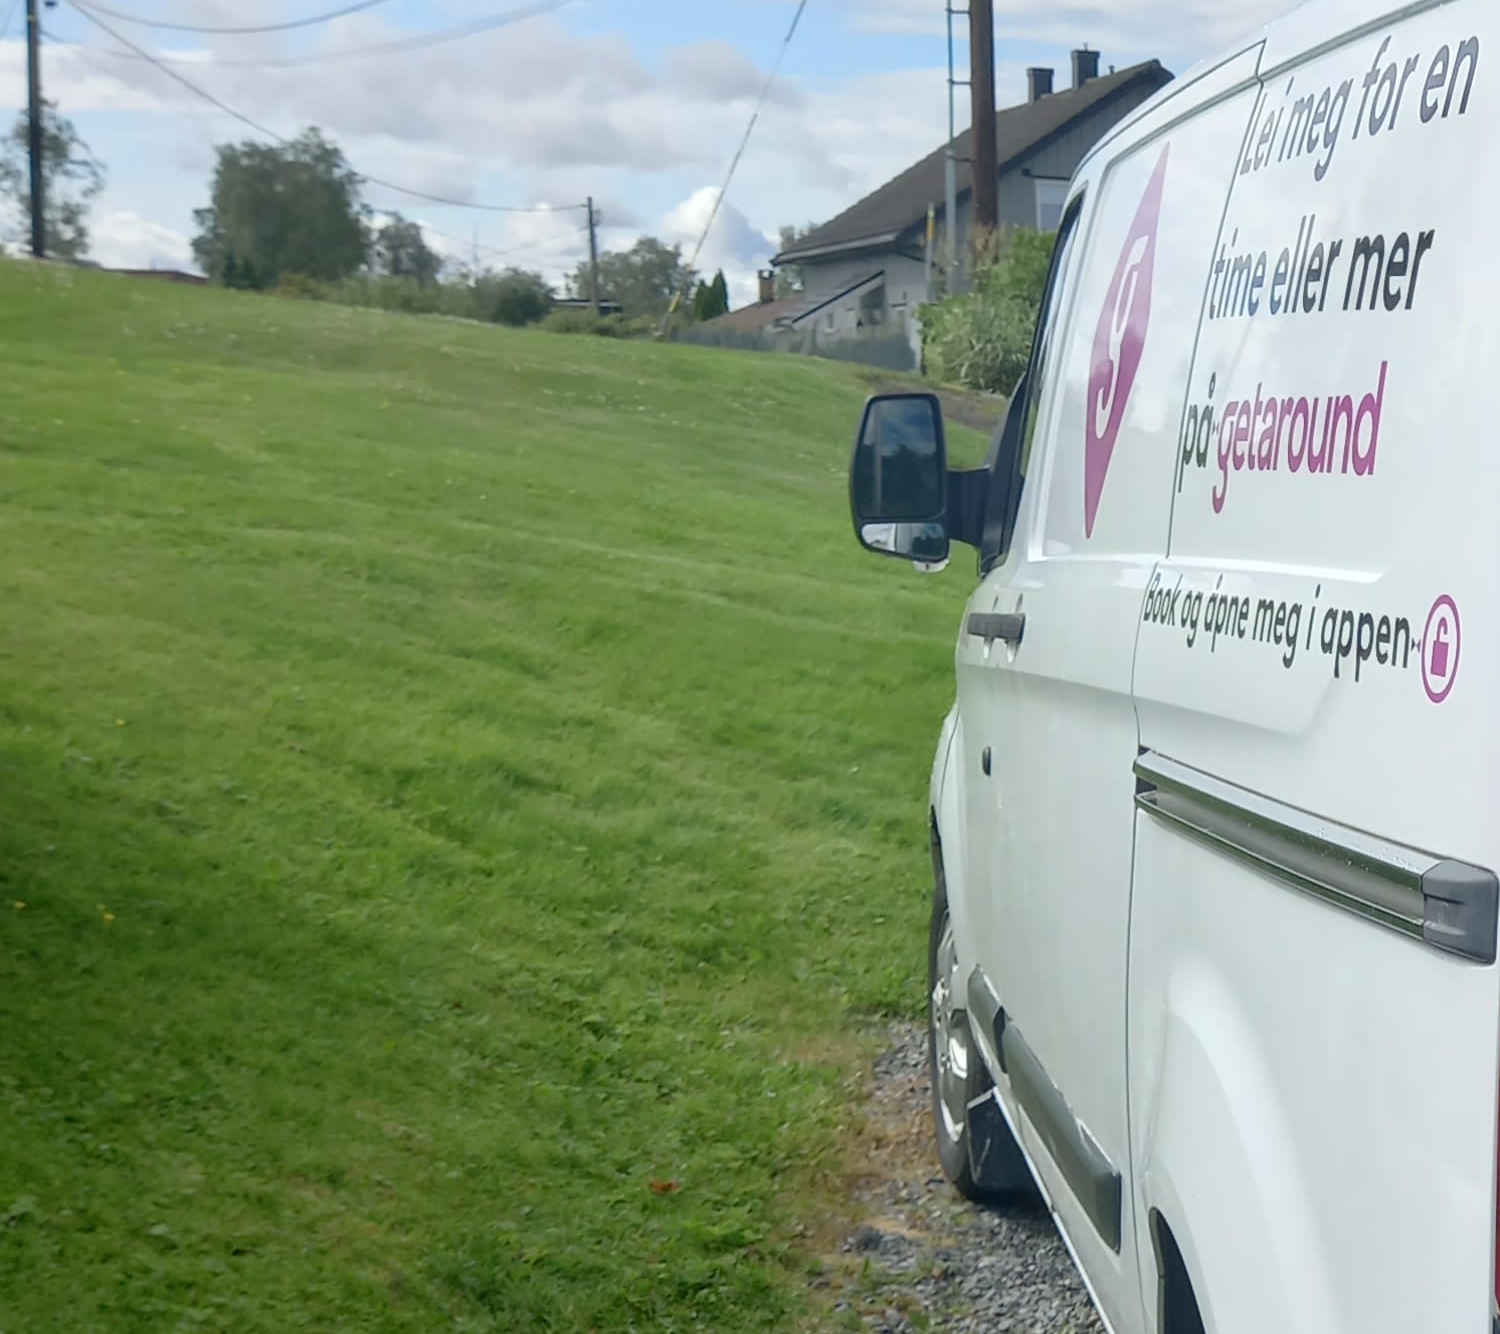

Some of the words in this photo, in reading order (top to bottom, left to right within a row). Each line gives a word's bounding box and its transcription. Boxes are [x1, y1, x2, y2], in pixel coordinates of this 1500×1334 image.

[1239, 76, 1294, 175] Lei
[1277, 78, 1353, 182] meg
[1352, 35, 1420, 140] for
[1420, 35, 1479, 123] en
[1209, 227, 1266, 319] time
[1269, 214, 1343, 315] eller
[1343, 229, 1435, 311] mer
[1178, 371, 1216, 493] på
[1212, 360, 1388, 514] getaround
[1143, 572, 1183, 626] Book
[1181, 589, 1203, 648] og
[1204, 574, 1250, 653] åpne
[1252, 598, 1302, 668] meg
[1306, 584, 1321, 650] i
[1320, 607, 1410, 682] appen
